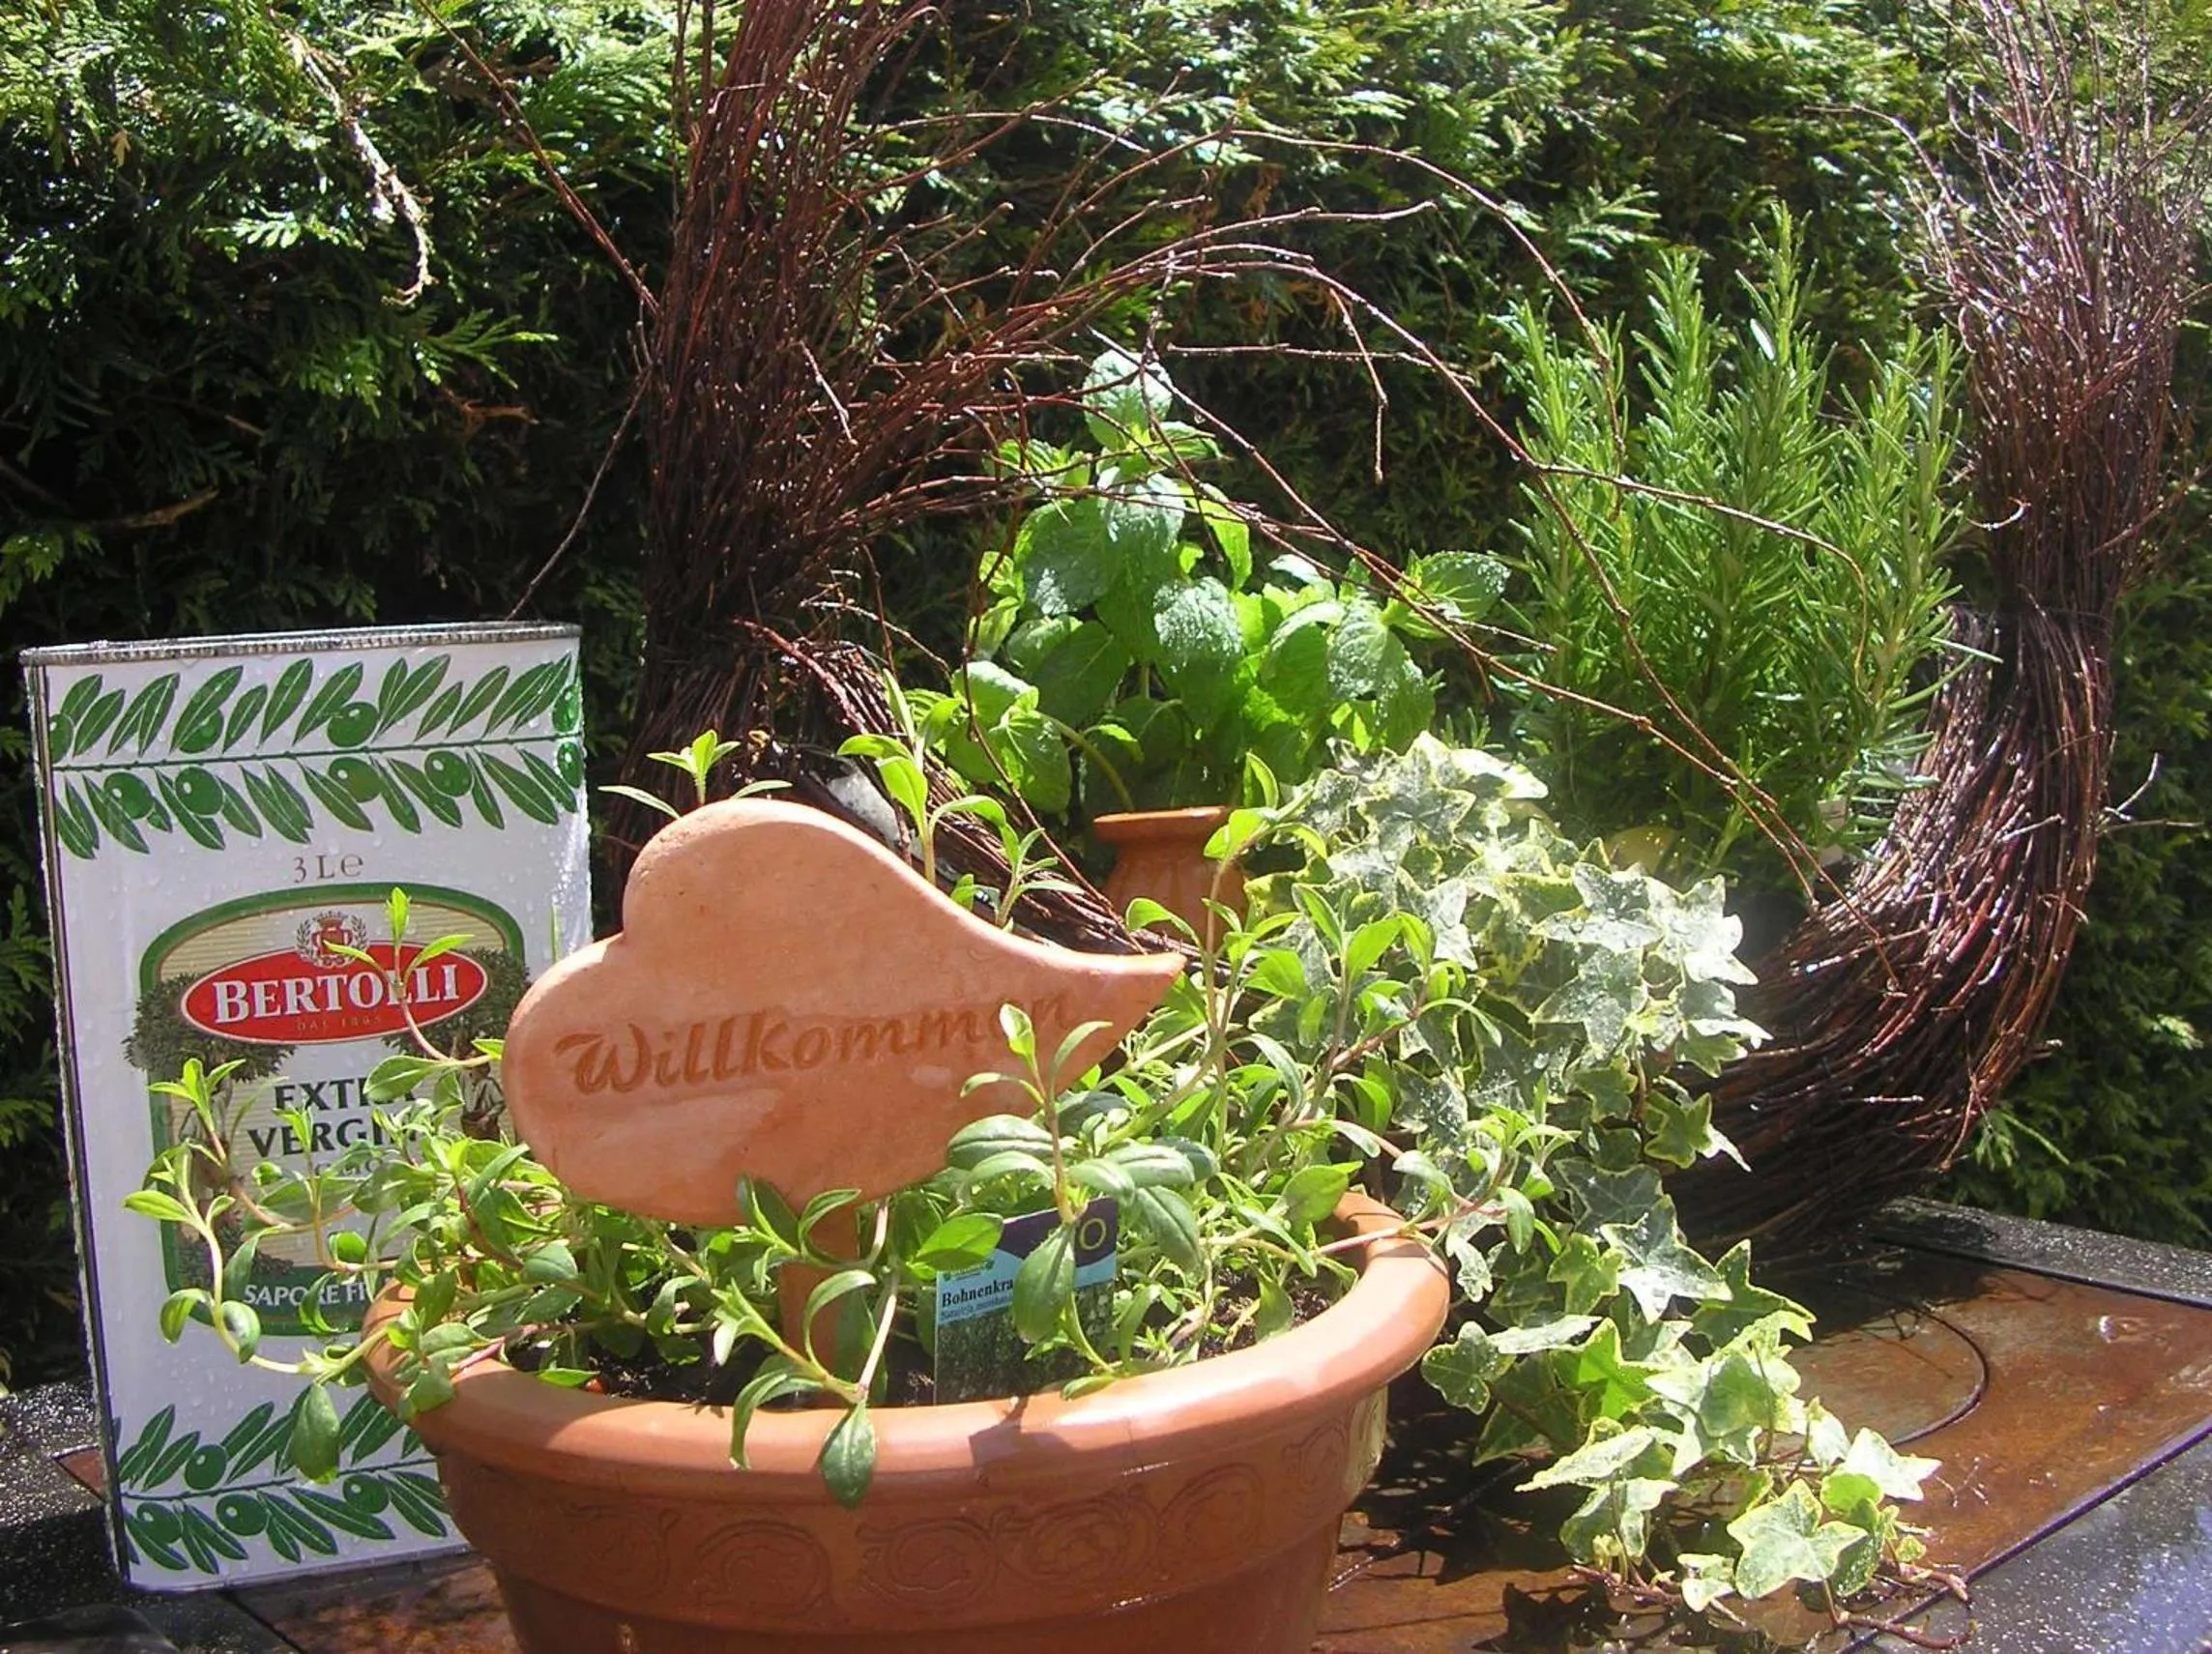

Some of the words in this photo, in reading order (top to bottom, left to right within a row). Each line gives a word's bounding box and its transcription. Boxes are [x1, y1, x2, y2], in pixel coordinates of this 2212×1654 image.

[275, 1076, 417, 1111] EXT
[247, 1112, 417, 1158] VERGI
[942, 1279, 1013, 1307] Bohnenkra
